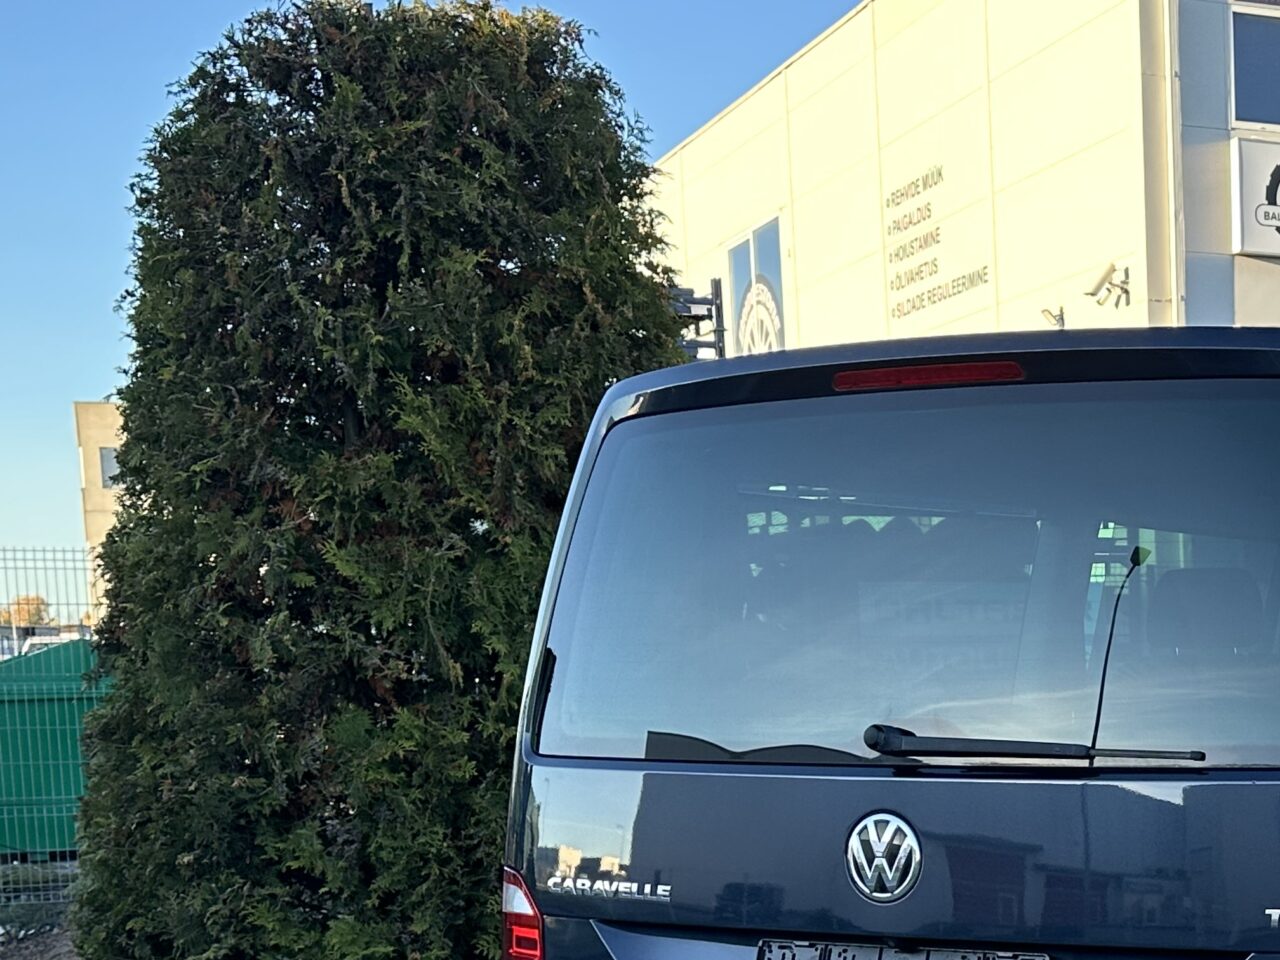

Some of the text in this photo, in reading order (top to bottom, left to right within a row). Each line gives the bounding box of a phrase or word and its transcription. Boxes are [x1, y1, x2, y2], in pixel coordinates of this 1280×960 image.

[890, 165, 944, 208] REHVIDE MÜÜK
[892, 202, 932, 235] PAIGALDUS
[893, 226, 941, 264] HOIUSTAMINE
[895, 257, 938, 291] ÕLIVAHETUS
[896, 265, 989, 319] SILDADE REGULEERIMINE
[547, 876, 672, 902] CARAVELLE
